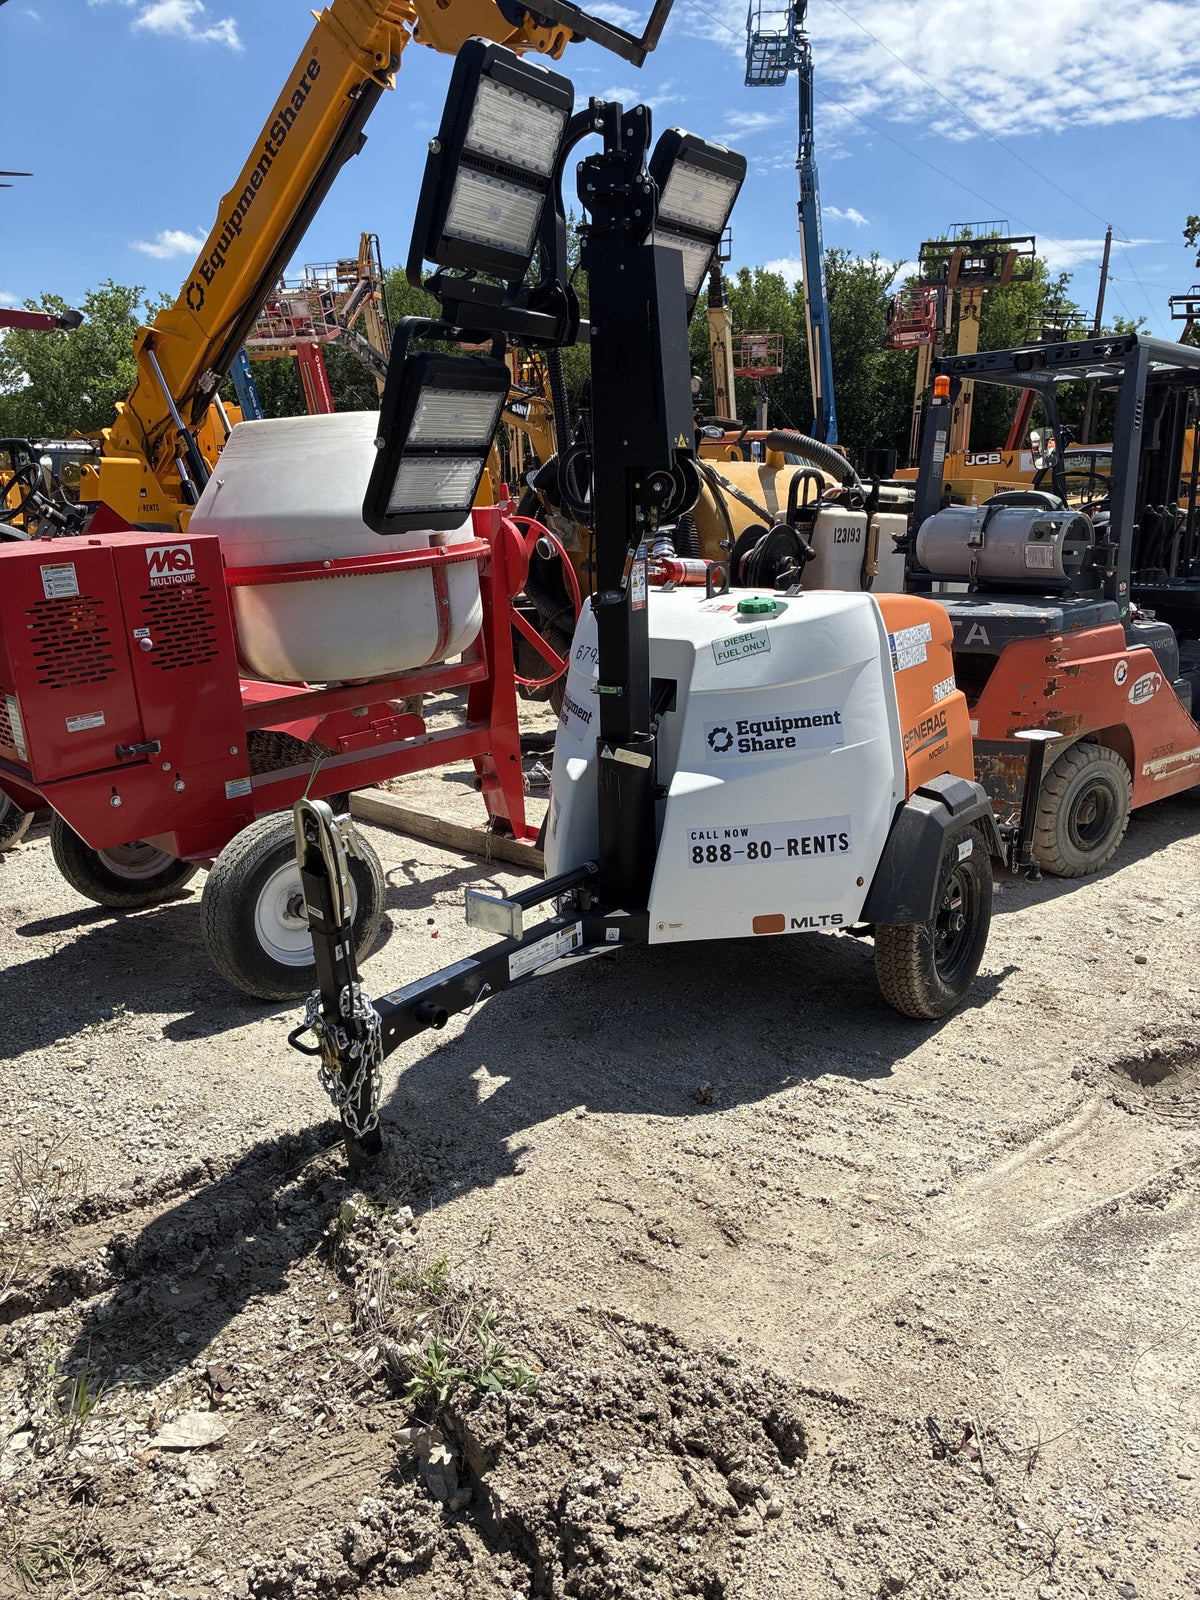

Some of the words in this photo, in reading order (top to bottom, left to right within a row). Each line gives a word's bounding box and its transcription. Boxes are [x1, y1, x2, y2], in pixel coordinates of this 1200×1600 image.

[199, 58, 321, 287] EquipmentShare
[965, 453, 1002, 466] JCB
[149, 549, 195, 573] MQ
[150, 574, 196, 588] MULTIQUIP
[724, 632, 757, 648] DIESEL
[1153, 637, 1175, 650] TOYOTA
[718, 648, 741, 661] FUEL
[742, 640, 767, 653] ONLY
[736, 710, 842, 737] Equipment
[903, 710, 948, 752] GENERAC
[737, 736, 797, 754] Share
[928, 741, 950, 761] MOBILE
[691, 830, 719, 841] CALL
[724, 828, 749, 838] NOW
[692, 832, 849, 865] 888-80-RENTS
[790, 913, 844, 930] MLTS
